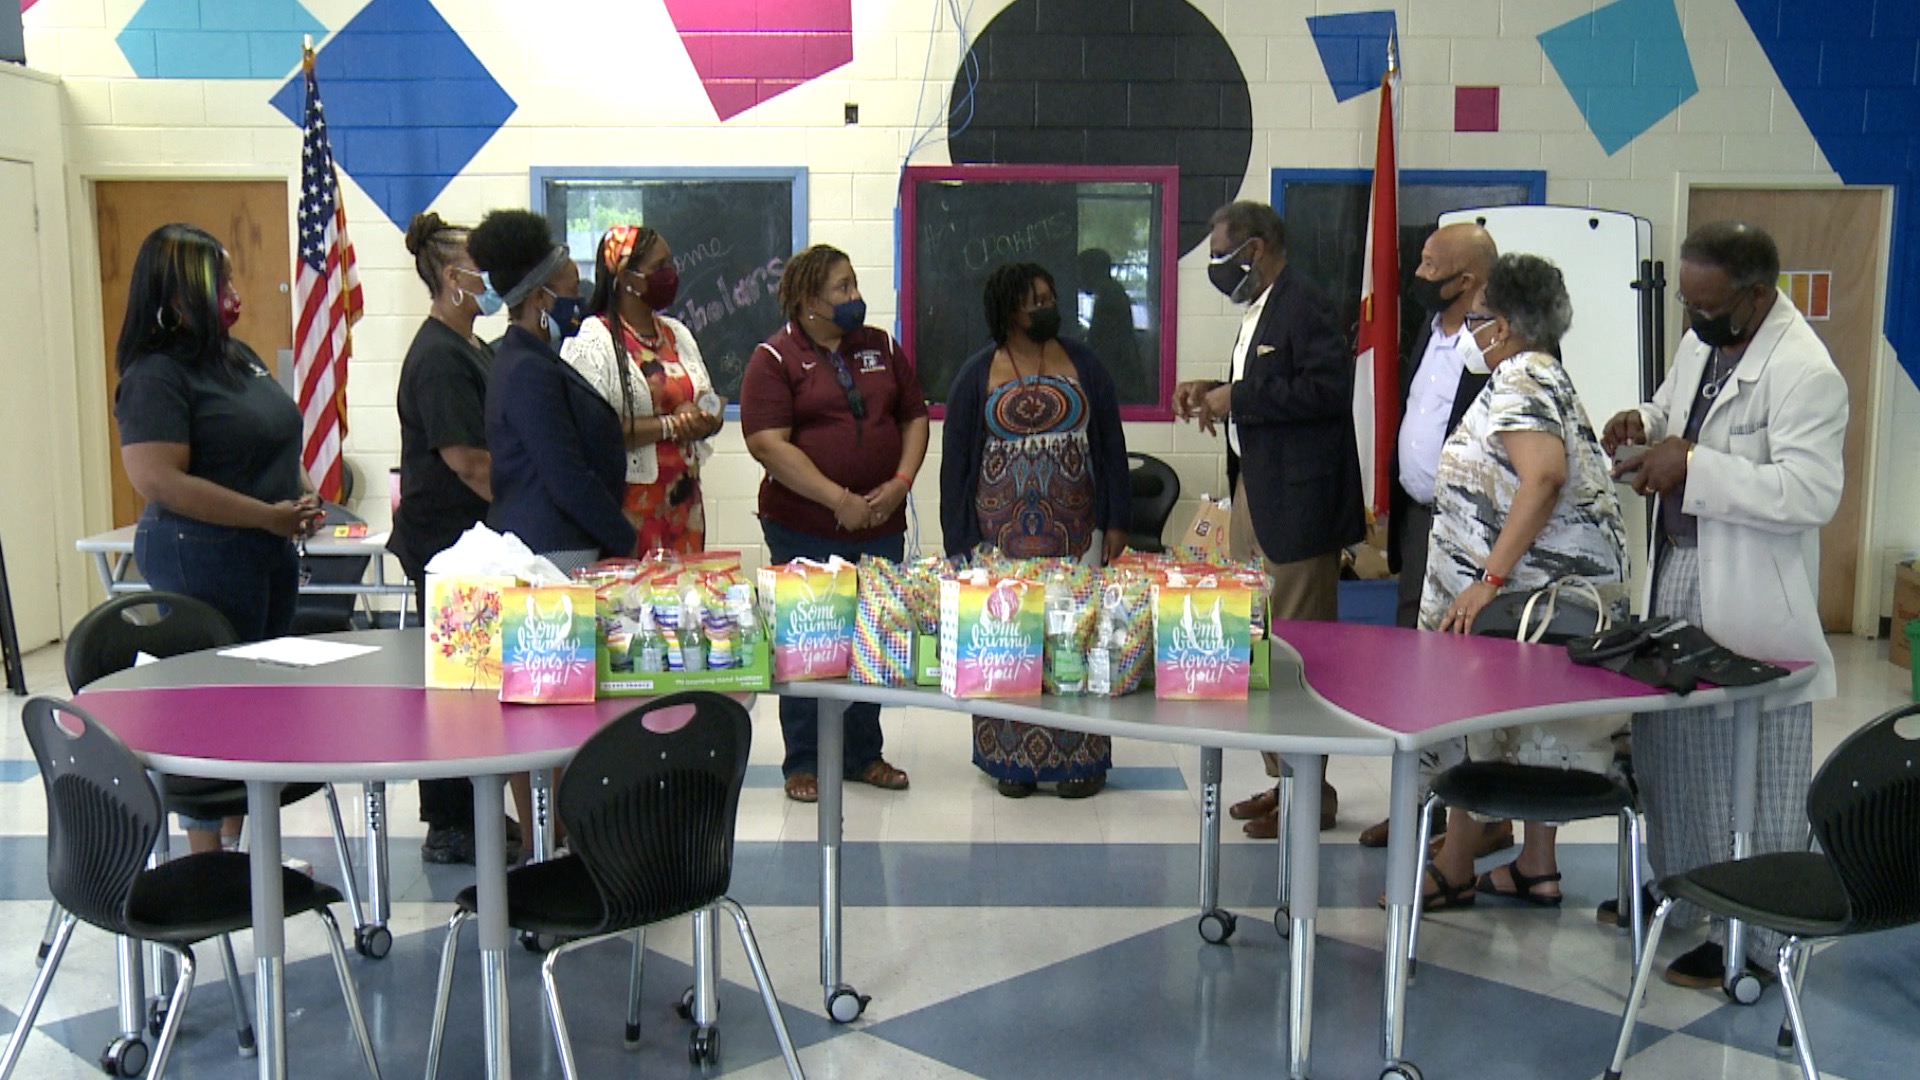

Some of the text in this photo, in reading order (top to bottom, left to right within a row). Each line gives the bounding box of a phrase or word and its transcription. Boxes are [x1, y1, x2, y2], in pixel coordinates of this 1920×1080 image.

[796, 601, 836, 621] Some
[787, 611, 846, 642] bunny
[968, 623, 1031, 658] bunny
[798, 633, 832, 652] loves
[525, 650, 563, 671] loves
[801, 643, 838, 675] you!
[979, 647, 1016, 671] loves
[1180, 651, 1218, 675] loves
[530, 663, 572, 697] you!
[981, 661, 1021, 692] you!
[1185, 664, 1224, 694] you!
